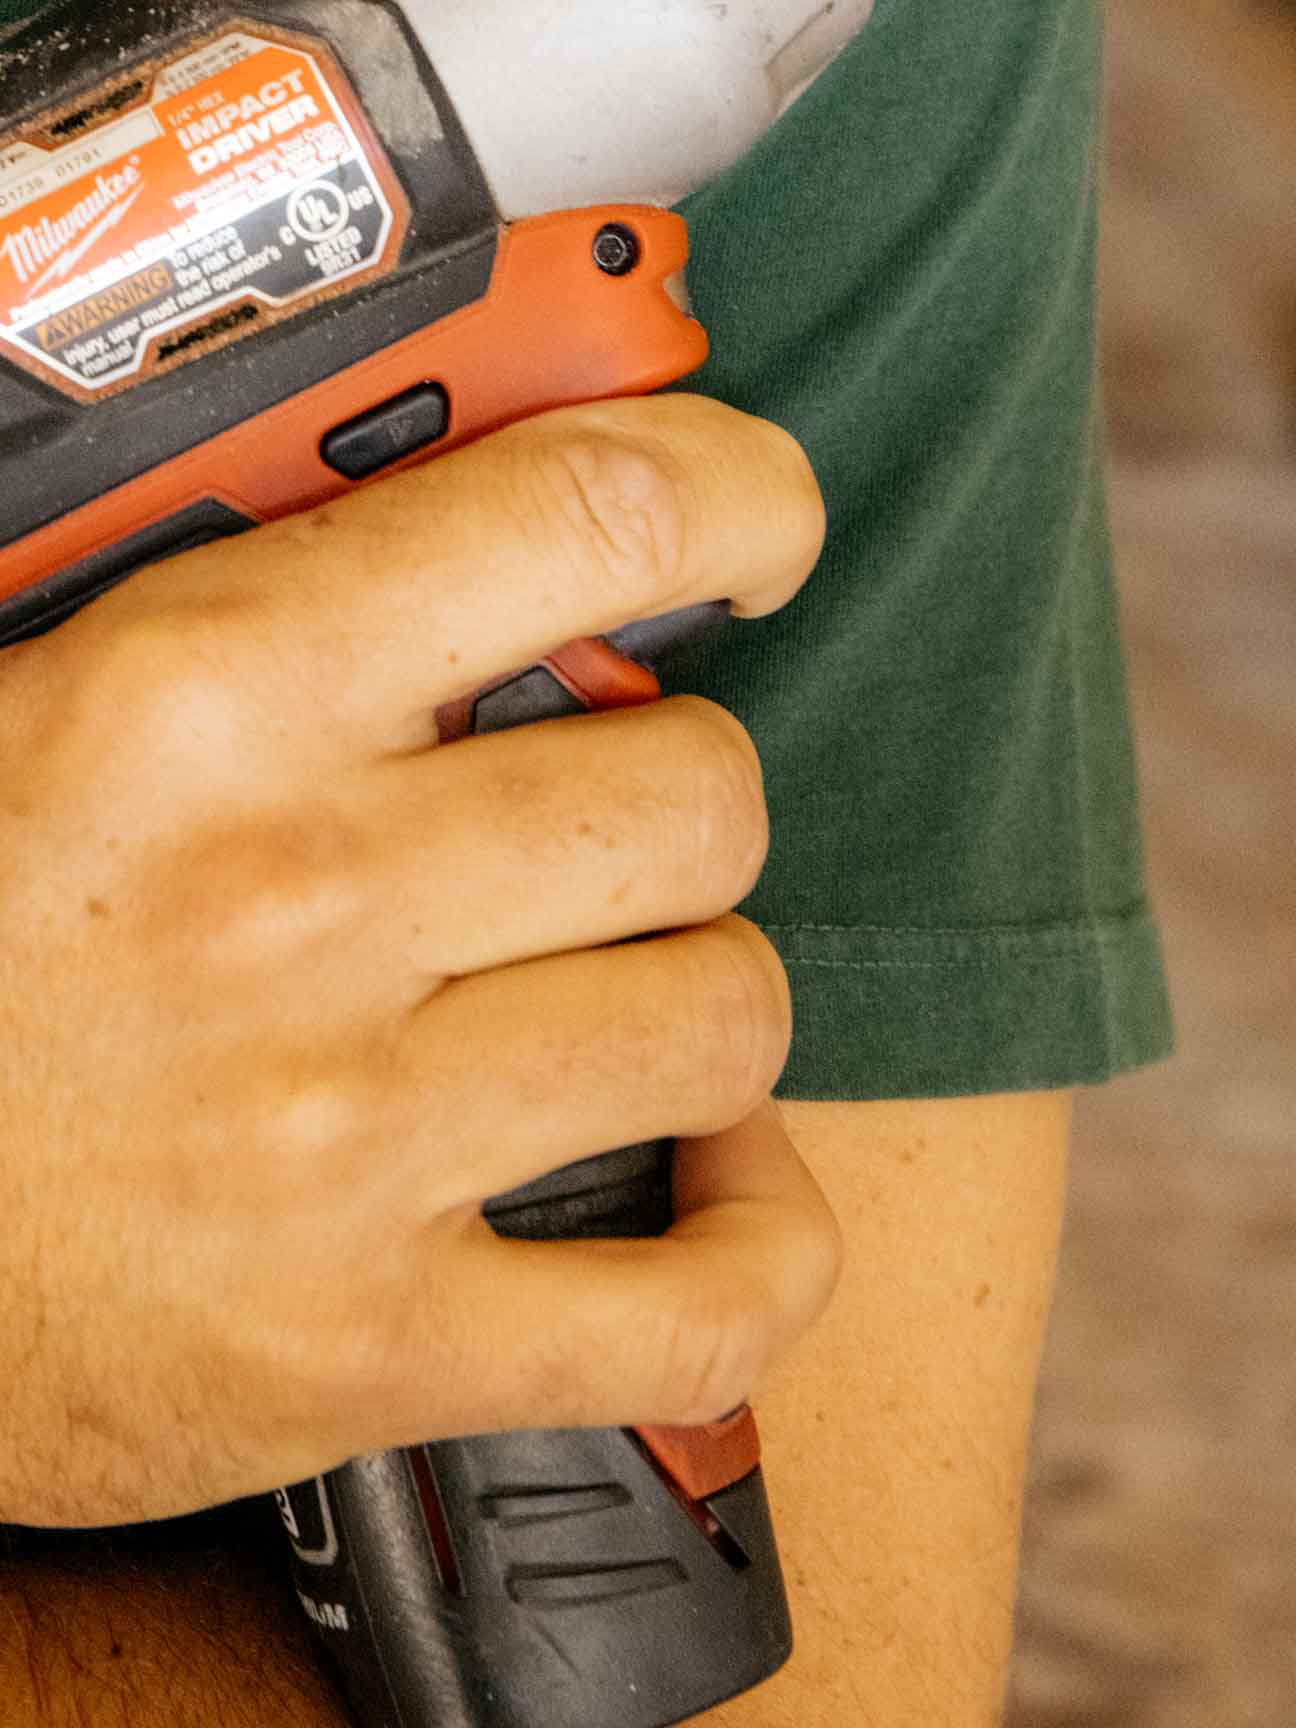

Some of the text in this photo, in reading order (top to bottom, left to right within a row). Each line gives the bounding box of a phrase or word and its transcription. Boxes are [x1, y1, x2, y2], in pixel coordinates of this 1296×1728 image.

[176, 70, 304, 150] IMPACT
[188, 95, 319, 175] DRIVER
[0, 161, 142, 282] Milwaukee
[305, 225, 363, 267] LISTED
[58, 265, 172, 336] WARNING
[107, 317, 141, 344] user
[140, 296, 179, 327] must
[176, 277, 212, 309] read
[210, 245, 283, 291] operator's
[175, 264, 203, 288] the
[201, 251, 231, 277] risk
